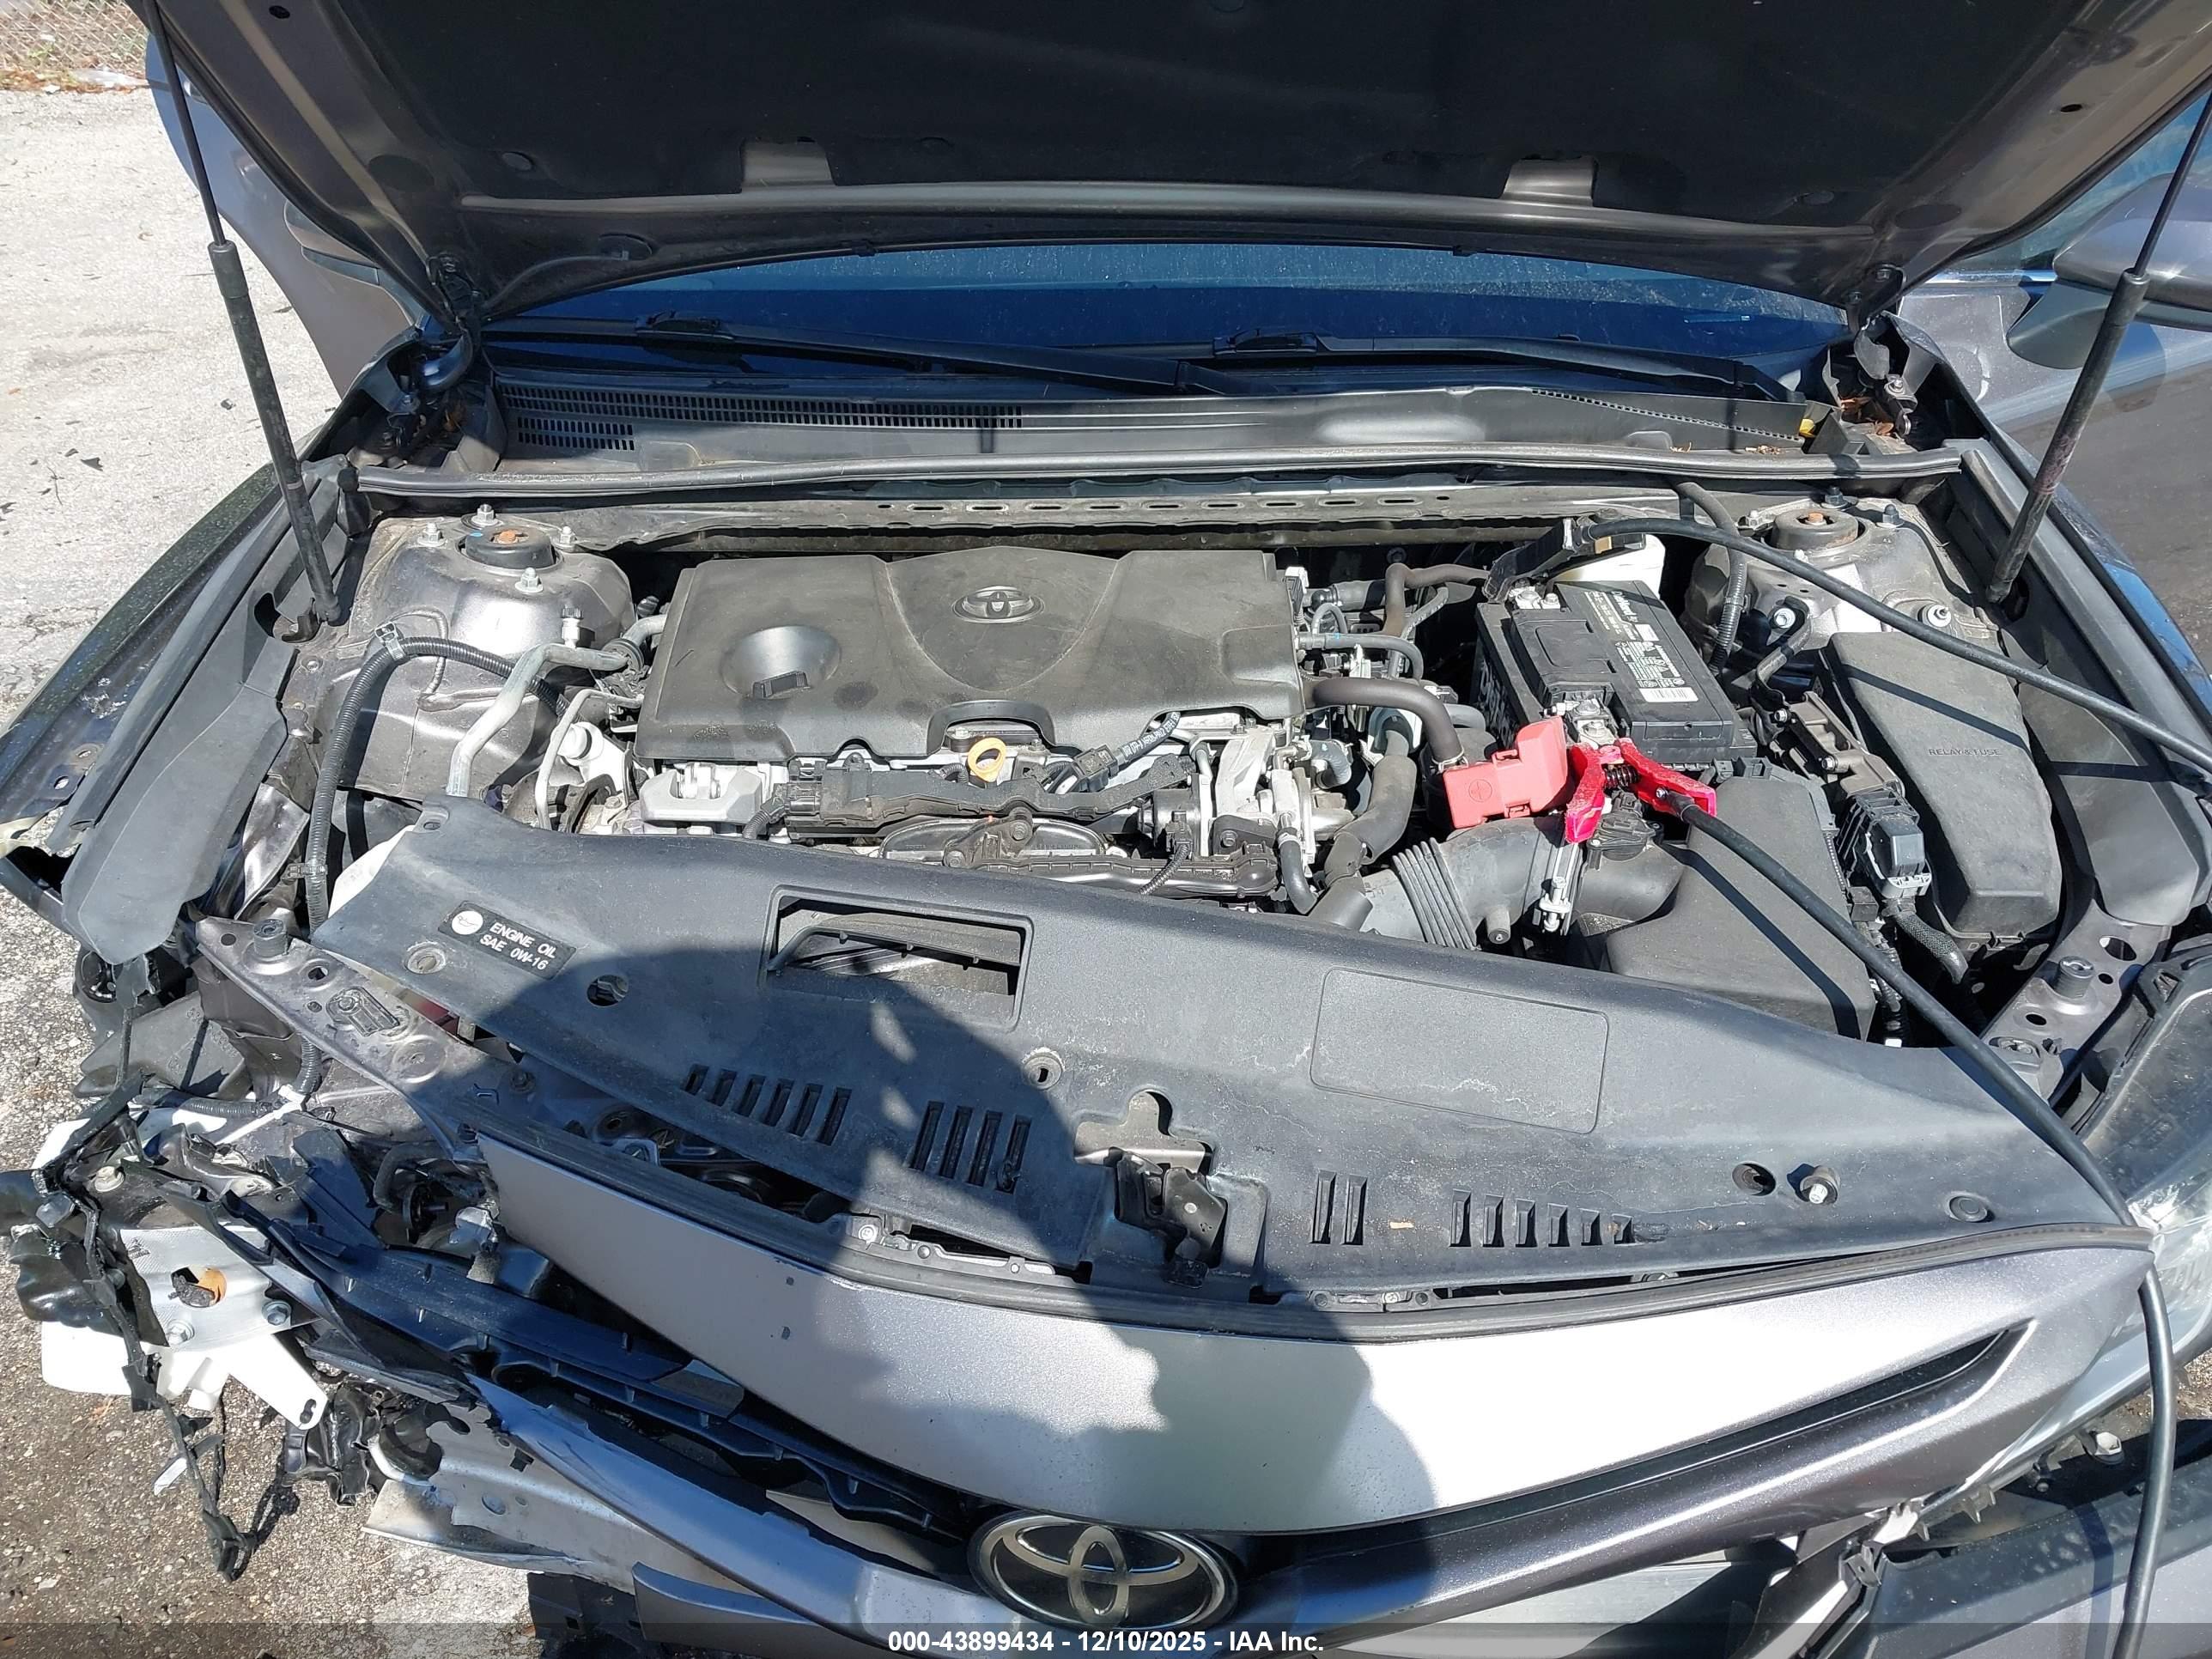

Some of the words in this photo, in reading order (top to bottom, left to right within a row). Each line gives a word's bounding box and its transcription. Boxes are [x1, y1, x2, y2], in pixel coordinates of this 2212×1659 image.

[479, 934, 507, 952] SAE
[510, 948, 549, 970] 0W-16
[489, 922, 535, 948] ENGINE
[538, 943, 556, 958] OIL
